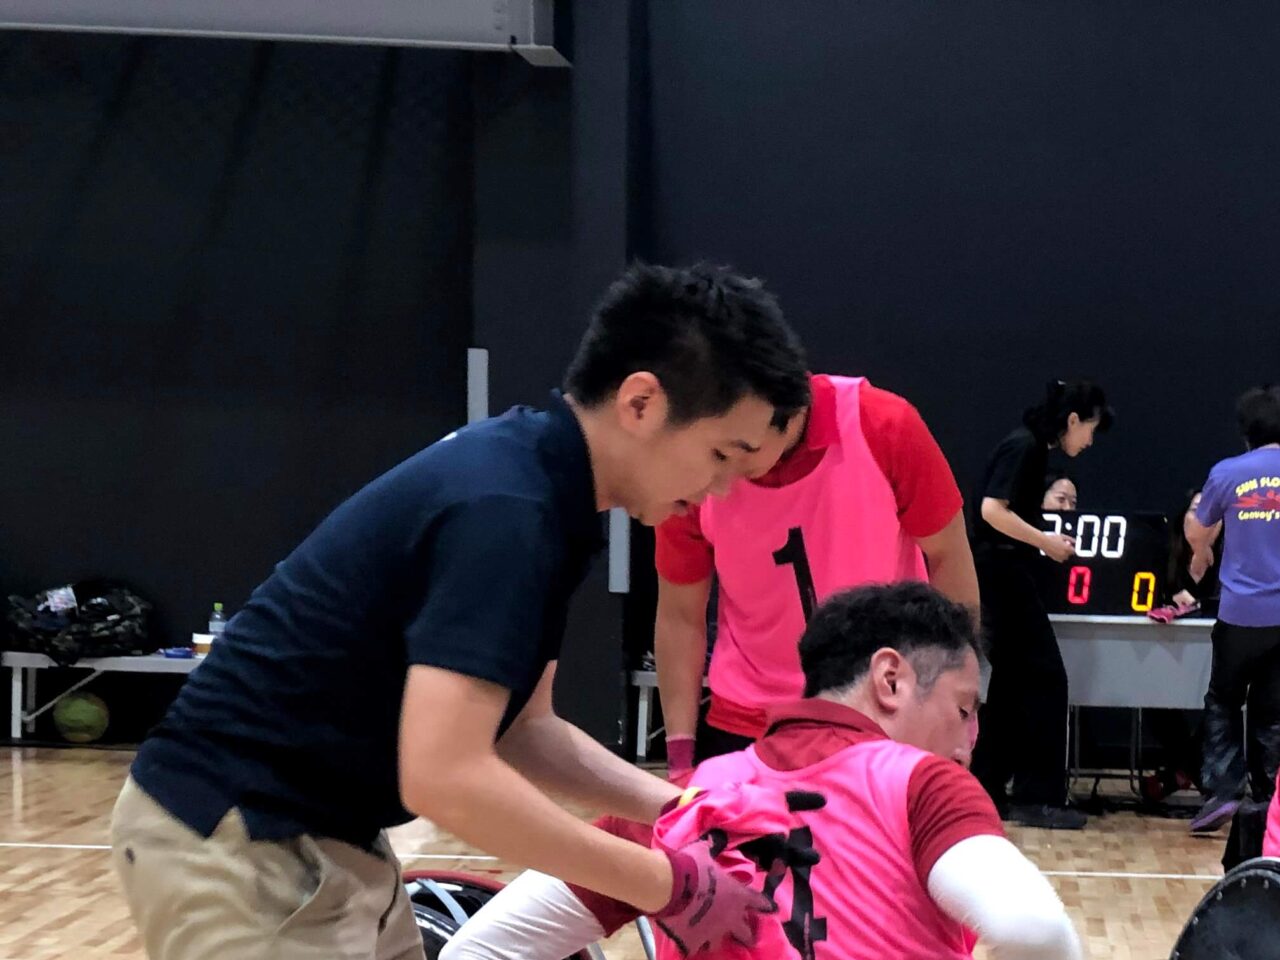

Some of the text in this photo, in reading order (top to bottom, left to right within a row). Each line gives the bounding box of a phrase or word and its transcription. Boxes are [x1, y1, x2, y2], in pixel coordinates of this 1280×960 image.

[1235, 478, 1259, 497] SUN
[771, 526, 818, 626] 1
[1068, 566, 1156, 612] 0 0
